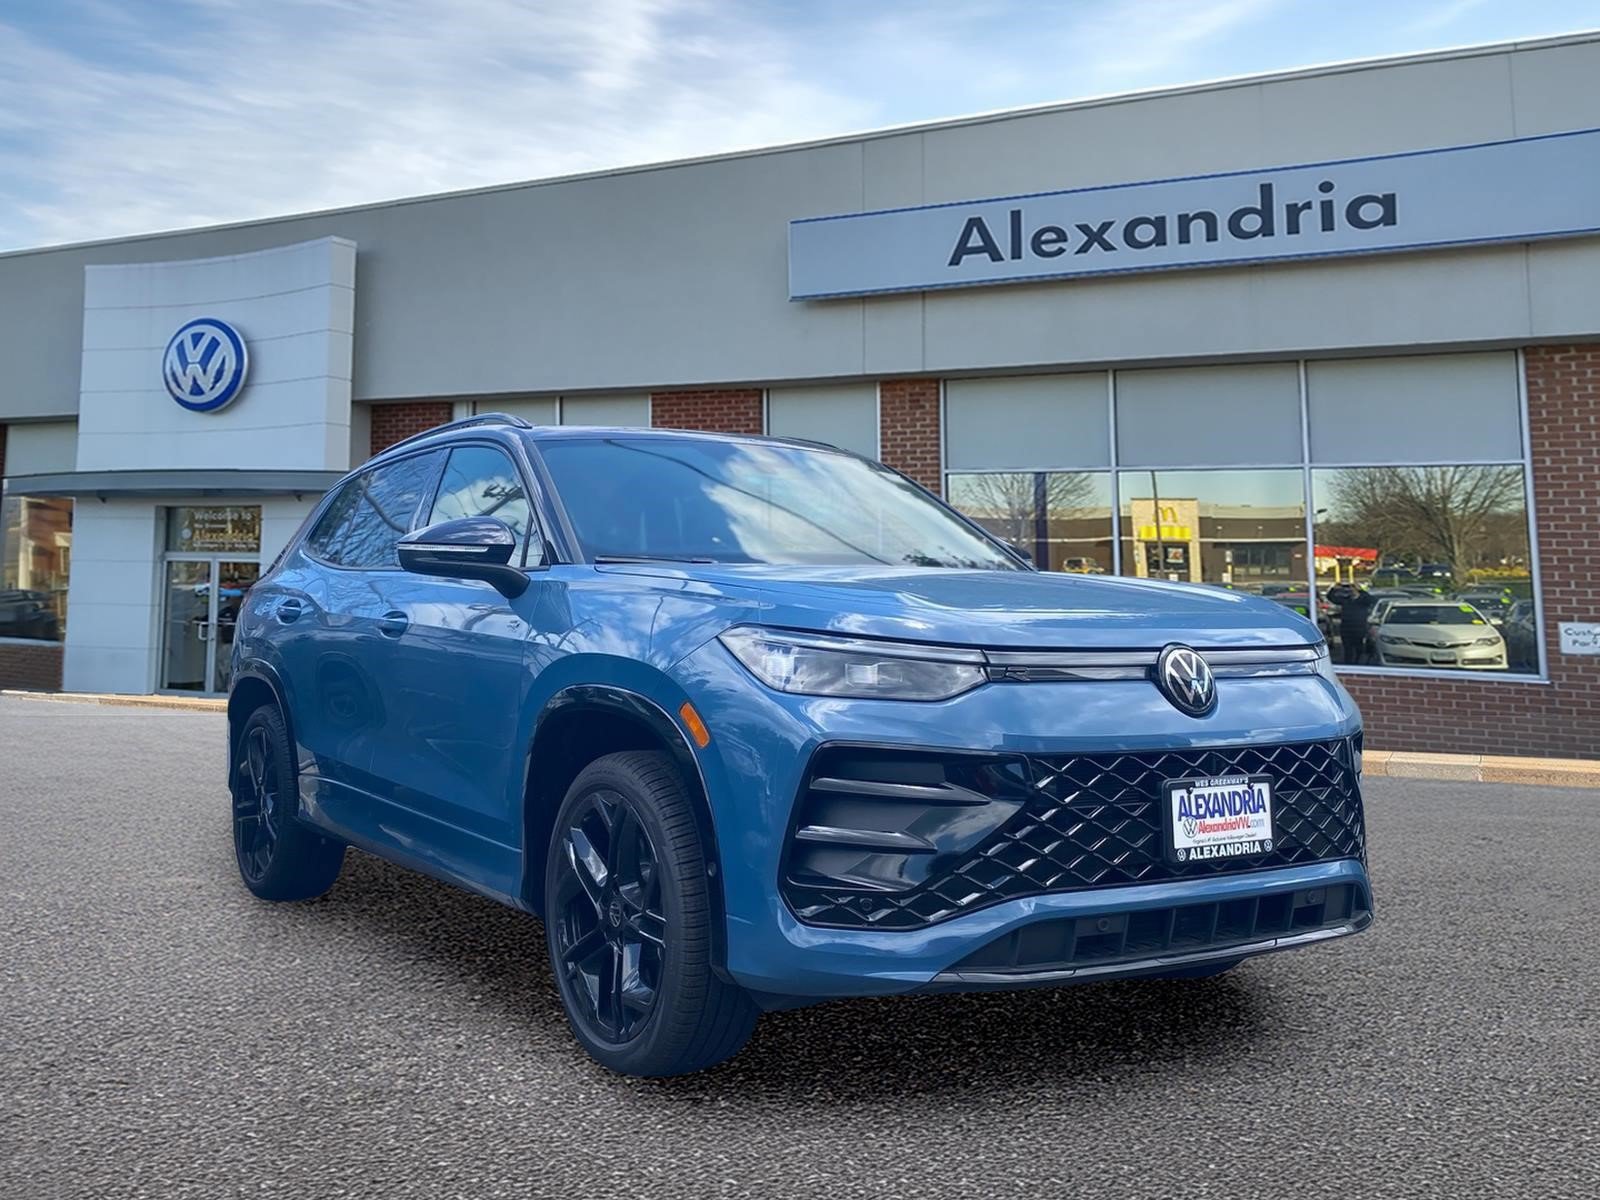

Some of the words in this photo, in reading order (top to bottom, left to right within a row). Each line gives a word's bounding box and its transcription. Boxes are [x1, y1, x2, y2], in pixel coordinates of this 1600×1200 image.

[947, 182, 1398, 267] Alexandria
[1178, 788, 1267, 821] ALEXANDRIA
[1189, 841, 1261, 860] ALEXANDRIA
